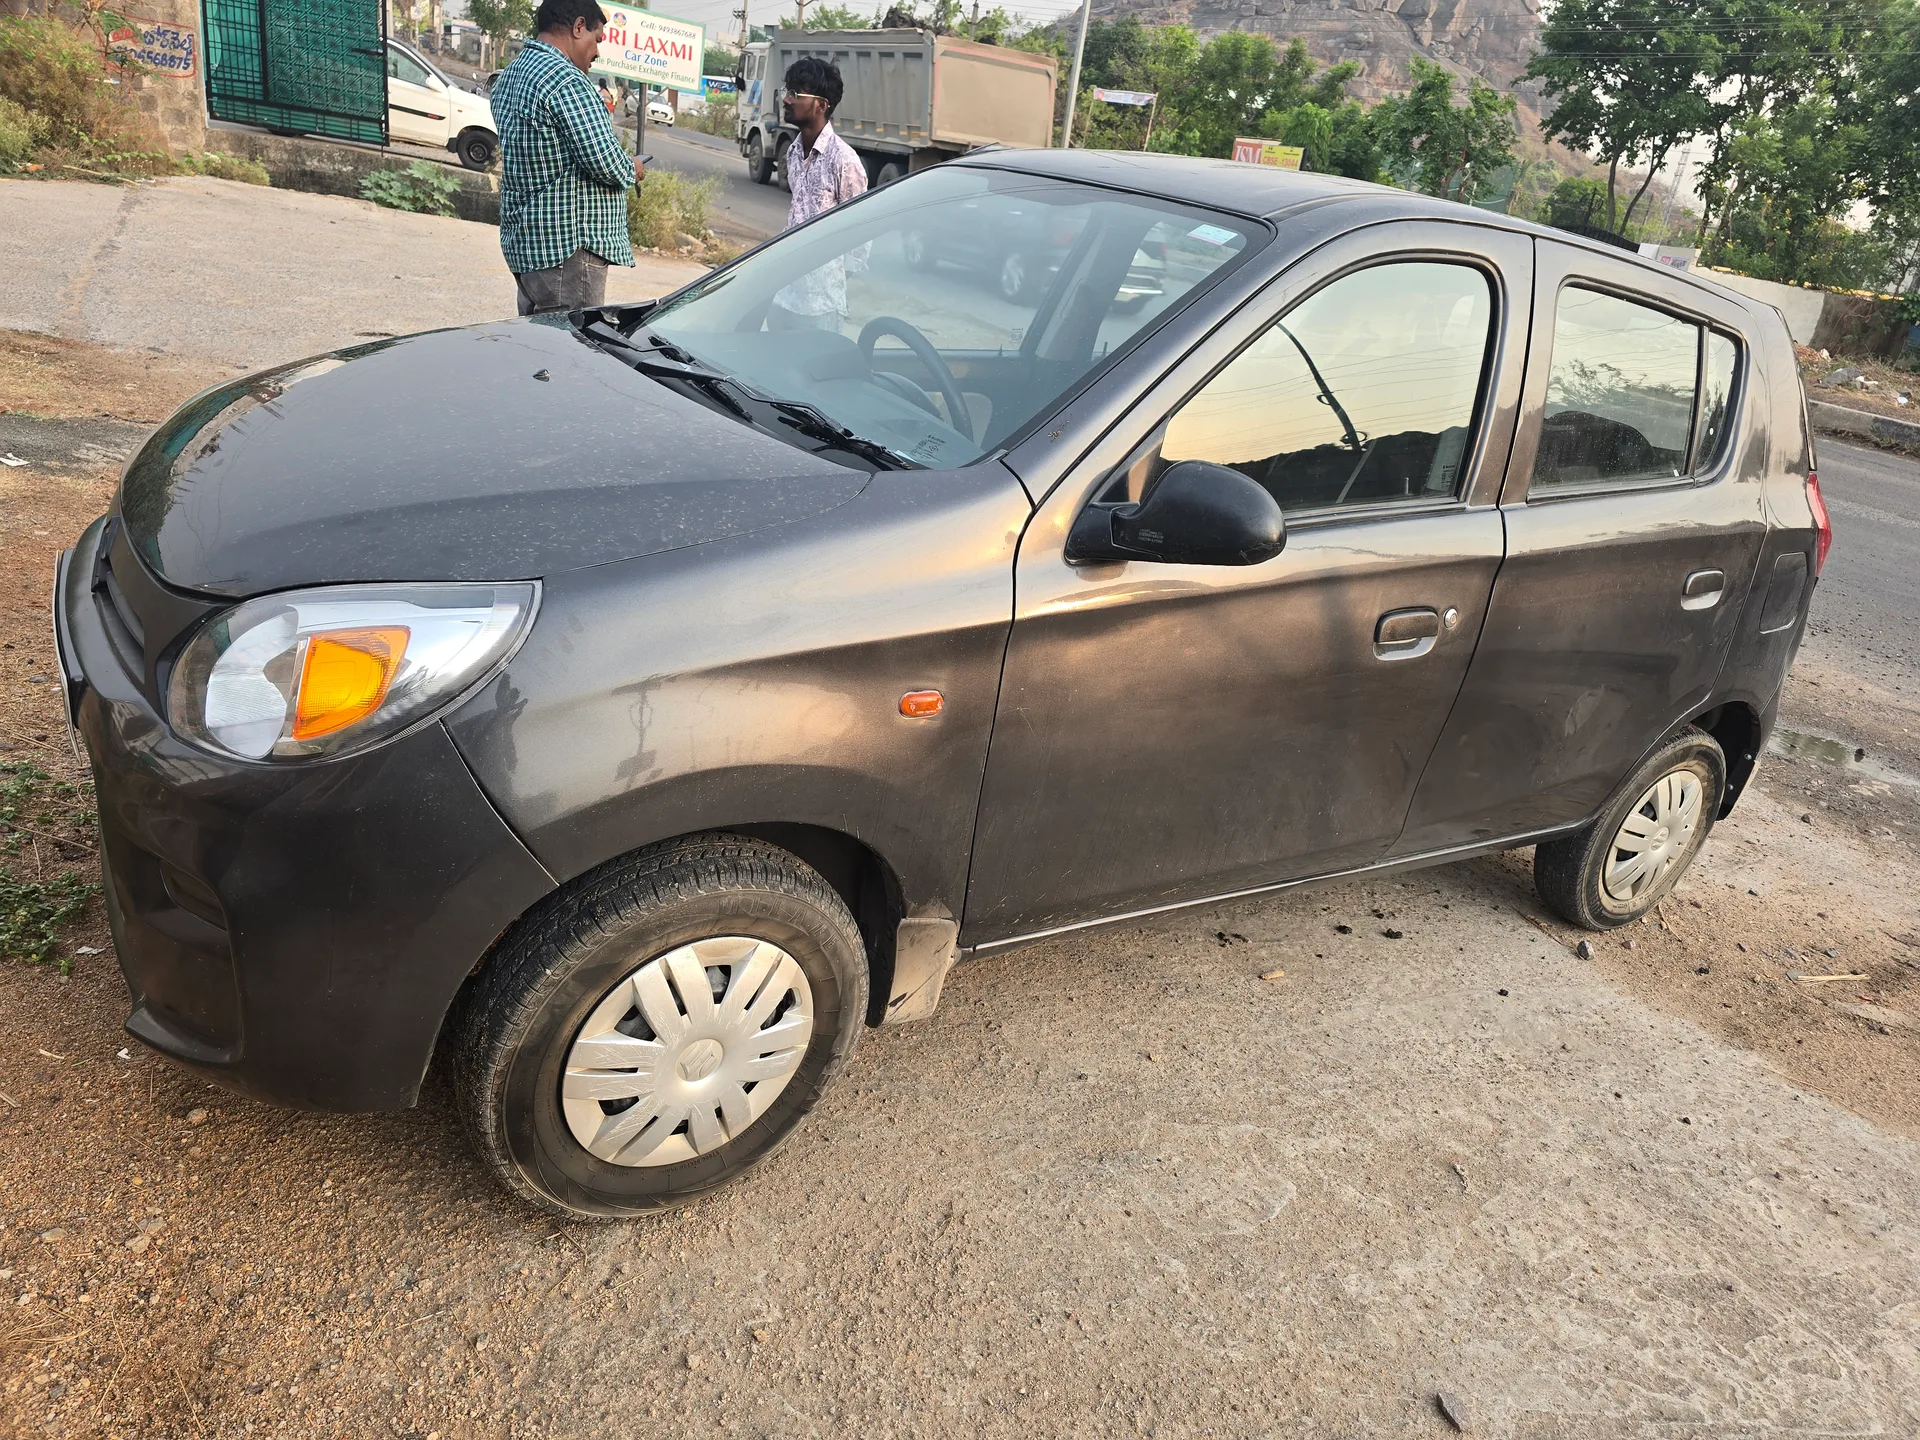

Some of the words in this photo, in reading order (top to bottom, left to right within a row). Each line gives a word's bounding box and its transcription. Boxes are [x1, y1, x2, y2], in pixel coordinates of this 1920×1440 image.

[624, 49, 642, 62] Car
[643, 53, 668, 68] Zone
[634, 33, 693, 61] LAXMI
[606, 58, 637, 71] Purchase
[638, 65, 670, 80] Exchange
[670, 71, 696, 84] Finance
